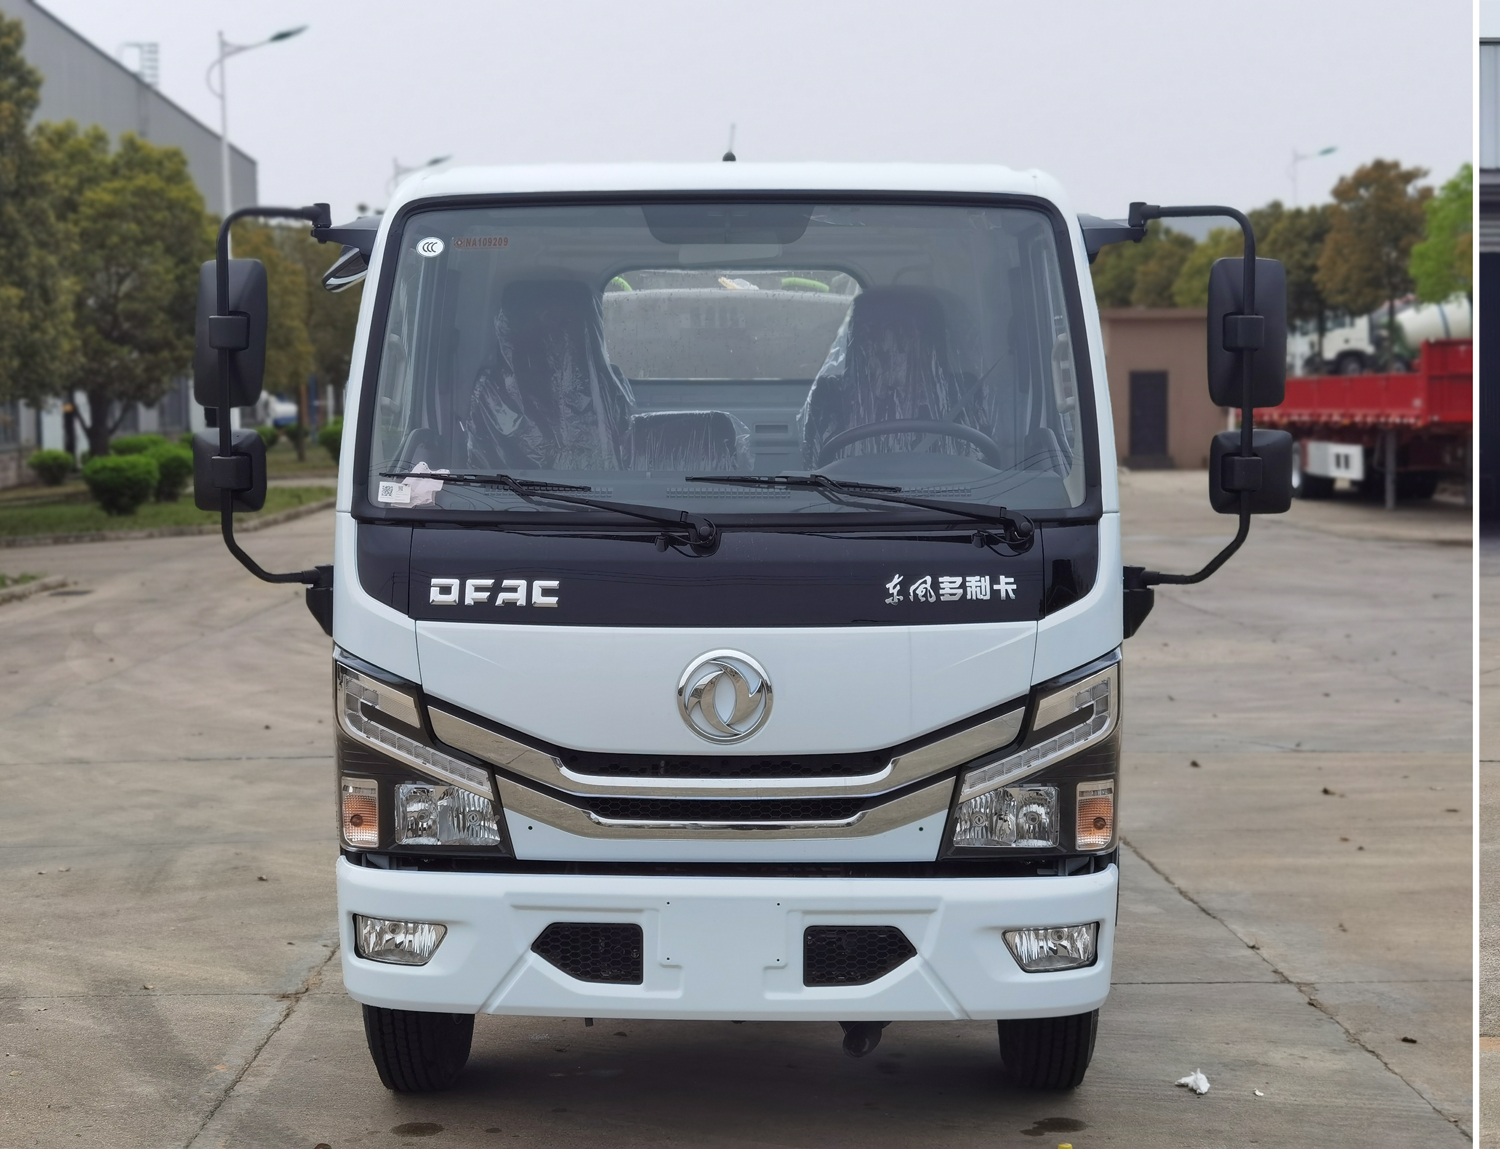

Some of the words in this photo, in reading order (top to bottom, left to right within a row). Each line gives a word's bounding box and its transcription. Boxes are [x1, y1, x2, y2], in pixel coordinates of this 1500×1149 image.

[429, 578, 560, 607] DFAC
[884, 573, 1017, 606] 东风多利卡
